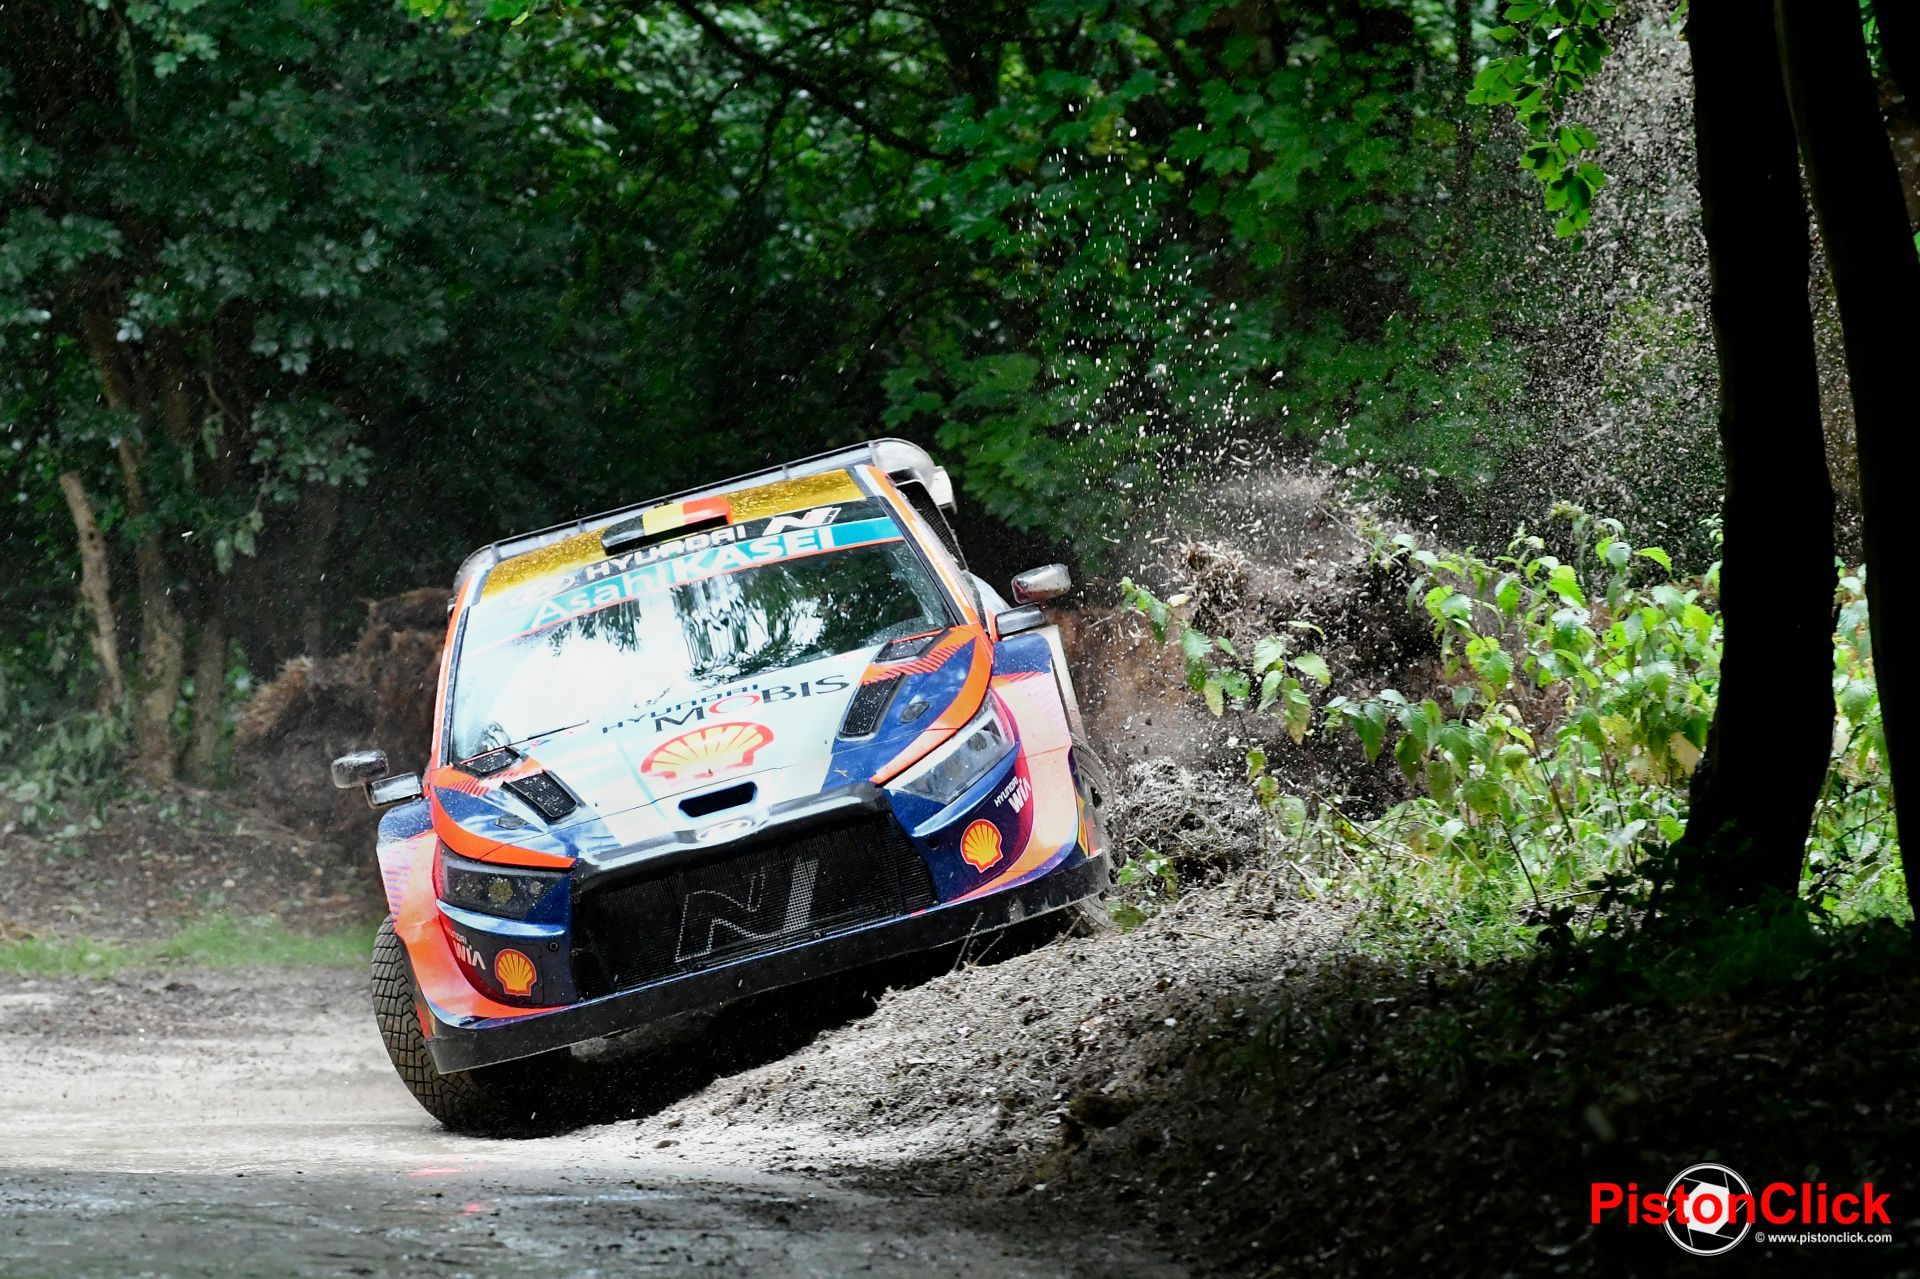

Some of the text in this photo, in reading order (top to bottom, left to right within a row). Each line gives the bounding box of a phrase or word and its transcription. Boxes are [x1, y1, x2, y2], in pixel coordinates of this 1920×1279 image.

[586, 526, 747, 581] HYUNDAI
[602, 683, 759, 734] HYUNDAI
[654, 675, 850, 733] MOBIS
